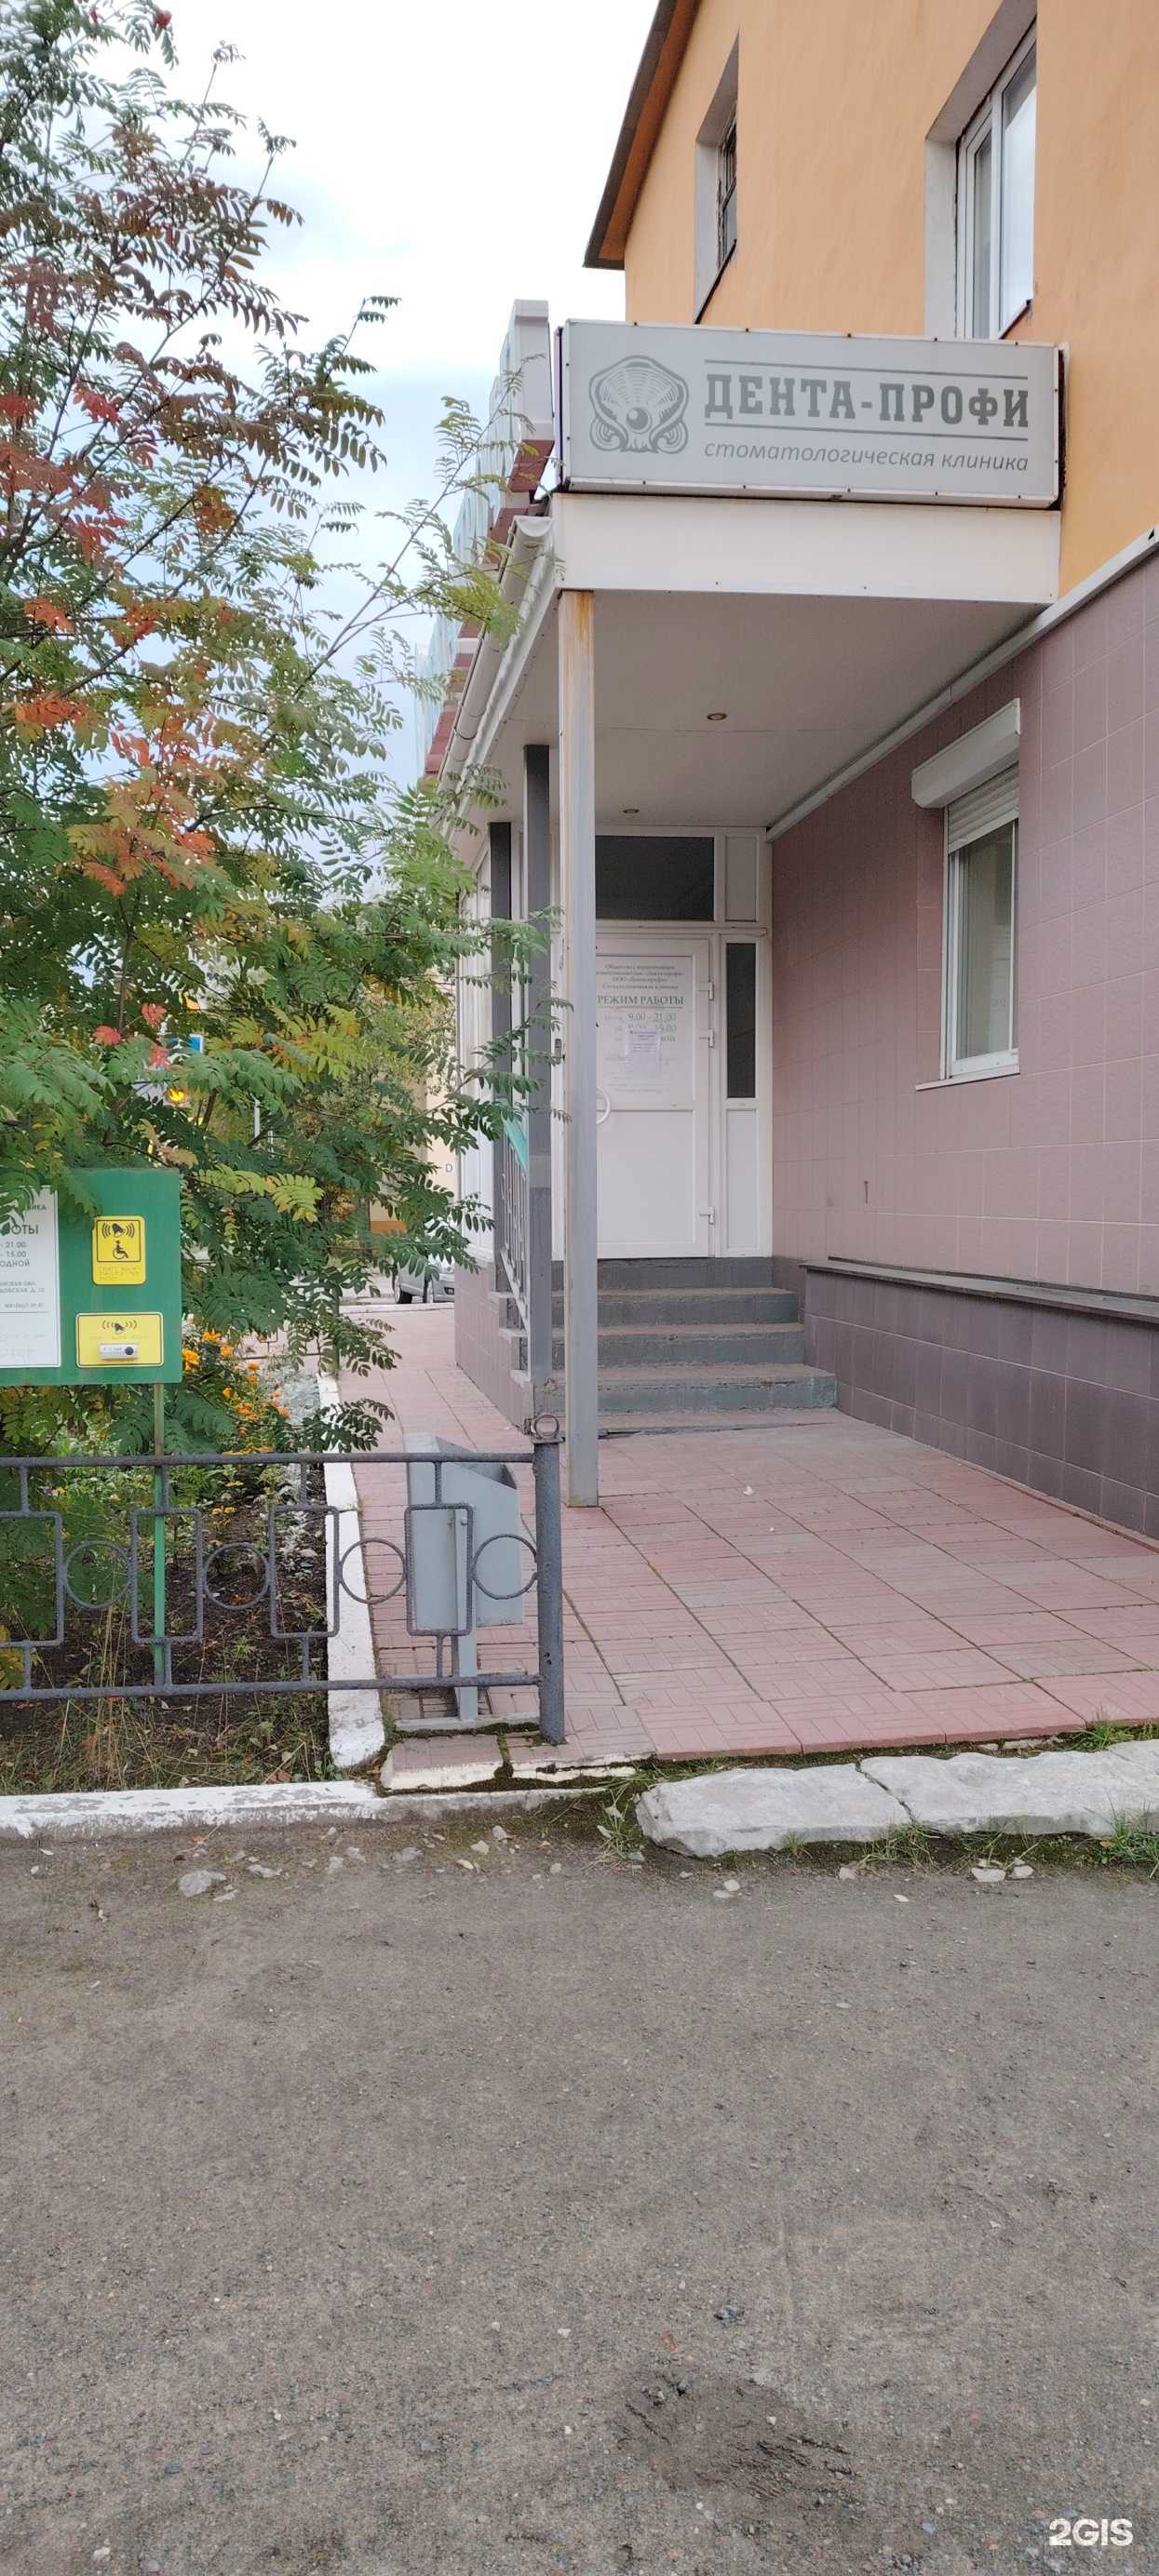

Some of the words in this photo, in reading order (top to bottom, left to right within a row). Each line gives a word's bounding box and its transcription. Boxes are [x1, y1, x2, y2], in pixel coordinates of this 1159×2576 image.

[704, 373, 1029, 428] ДЕНТА-ПРОФИ
[704, 439, 935, 468] стоматологическая
[941, 452, 1029, 472] клиника
[597, 996, 638, 1005] РЕЖИМ
[640, 996, 684, 1006] РАБОТЫ
[11, 1224, 38, 1236] ОТЫ
[0, 1259, 30, 1268] ОДНОЙ
